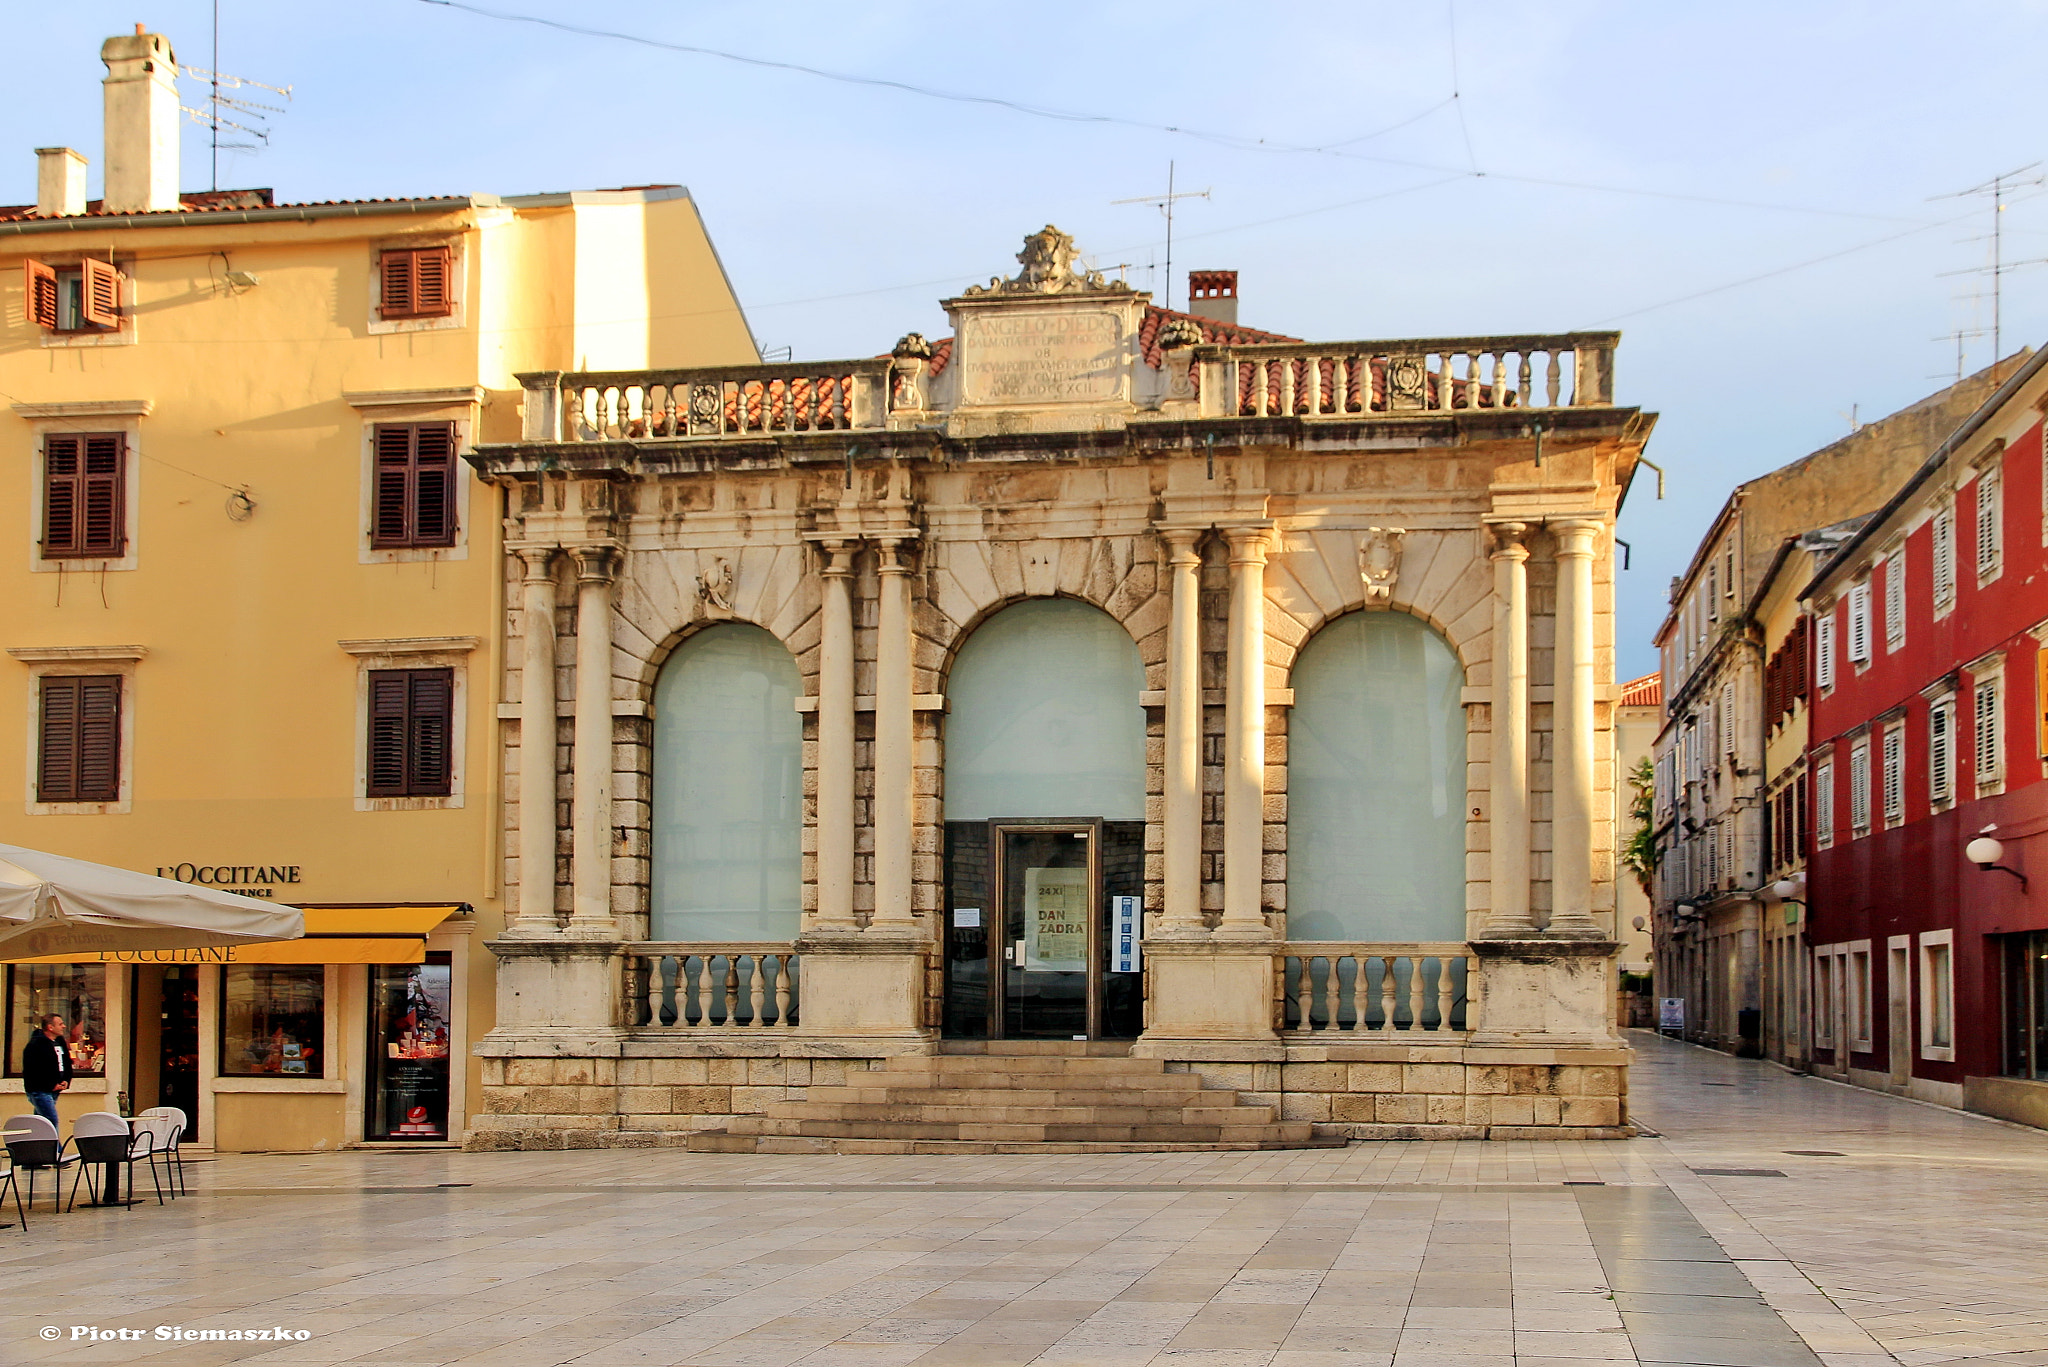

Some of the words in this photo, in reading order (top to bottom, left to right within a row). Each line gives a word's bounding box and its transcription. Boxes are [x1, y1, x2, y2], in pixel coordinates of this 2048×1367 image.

[1057, 316, 1113, 333] DIEDO
[156, 863, 301, 884] L'OCCITANE
[1039, 887, 1051, 895] 24
[1038, 910, 1065, 920] DAN
[1038, 923, 1084, 933] ZADRA
